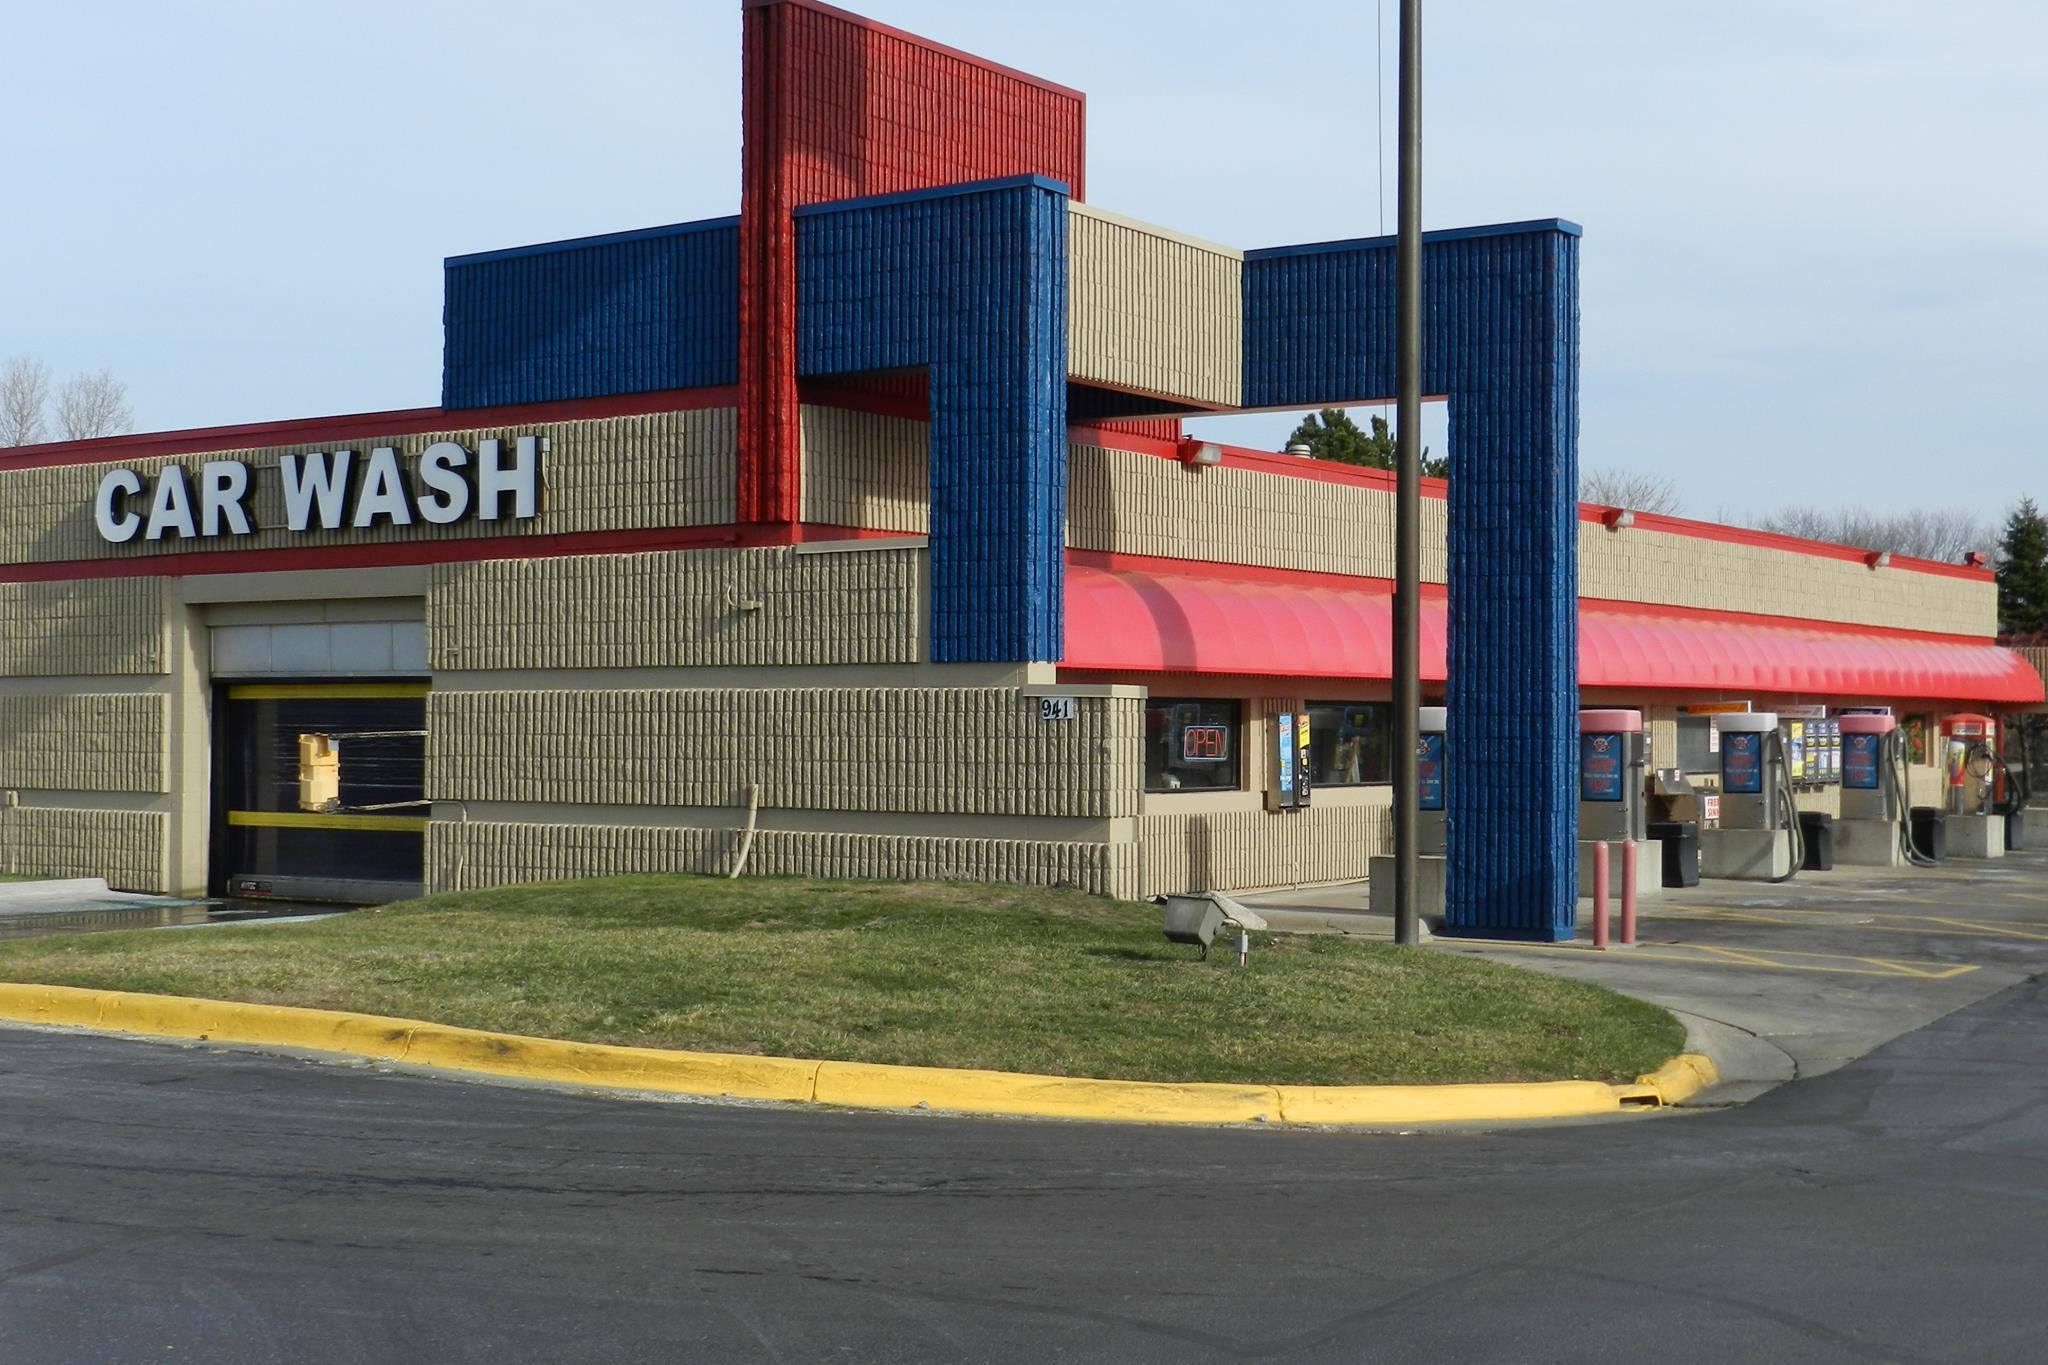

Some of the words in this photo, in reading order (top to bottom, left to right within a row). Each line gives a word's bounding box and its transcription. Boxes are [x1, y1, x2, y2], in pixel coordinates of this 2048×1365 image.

[95, 459, 252, 543] CAR
[279, 435, 538, 532] WASH
[1041, 699, 1069, 719] 941
[1186, 729, 1226, 757] OPEN
